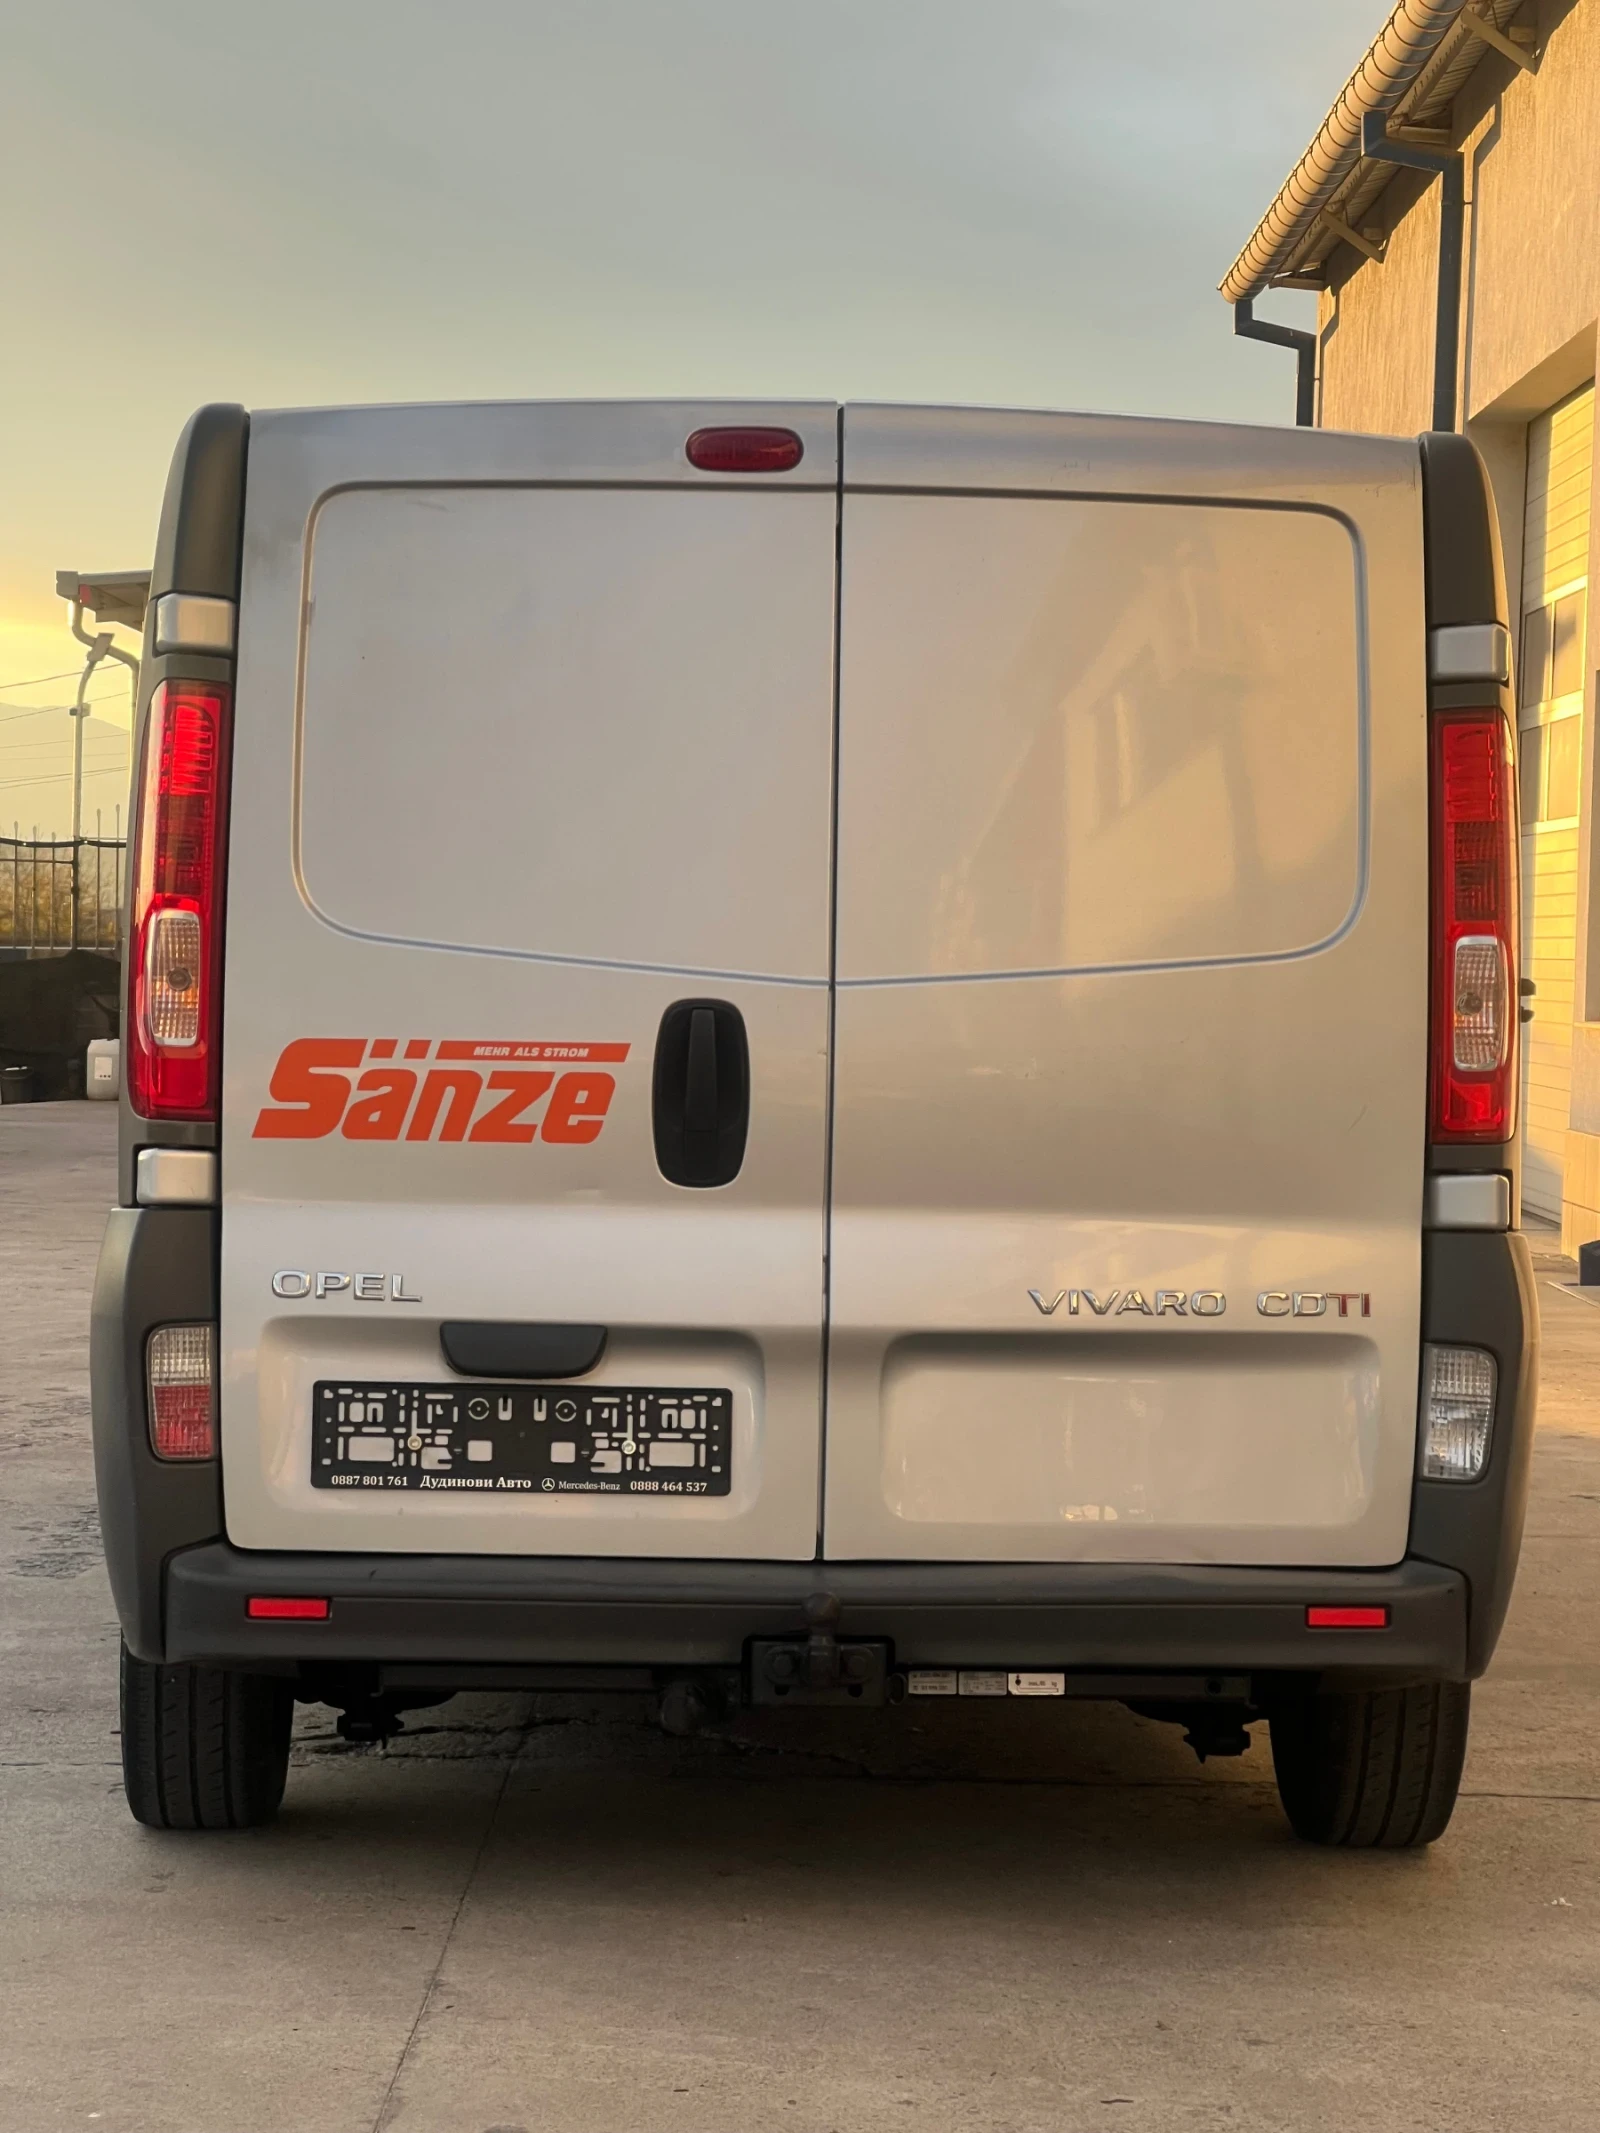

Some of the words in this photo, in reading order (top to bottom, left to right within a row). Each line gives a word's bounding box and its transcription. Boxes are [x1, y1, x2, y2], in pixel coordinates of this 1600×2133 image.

[473, 1046, 511, 1056] MEHR
[514, 1047, 540, 1057] ALS
[543, 1048, 590, 1058] STROM
[251, 1038, 616, 1144] Sänze
[271, 1269, 423, 1302] OPEL
[1027, 1289, 1227, 1317] VIVARO
[1256, 1291, 1372, 1318] CDTI
[331, 1475, 360, 1485] 0887
[362, 1475, 384, 1486] 801
[387, 1476, 409, 1486] 761
[420, 1475, 493, 1489] Дудинови
[496, 1477, 532, 1488] Авто
[558, 1481, 621, 1491] Mercedes-Benz
[630, 1480, 659, 1491] 0888
[661, 1481, 683, 1492] 464
[686, 1482, 708, 1493] 537
